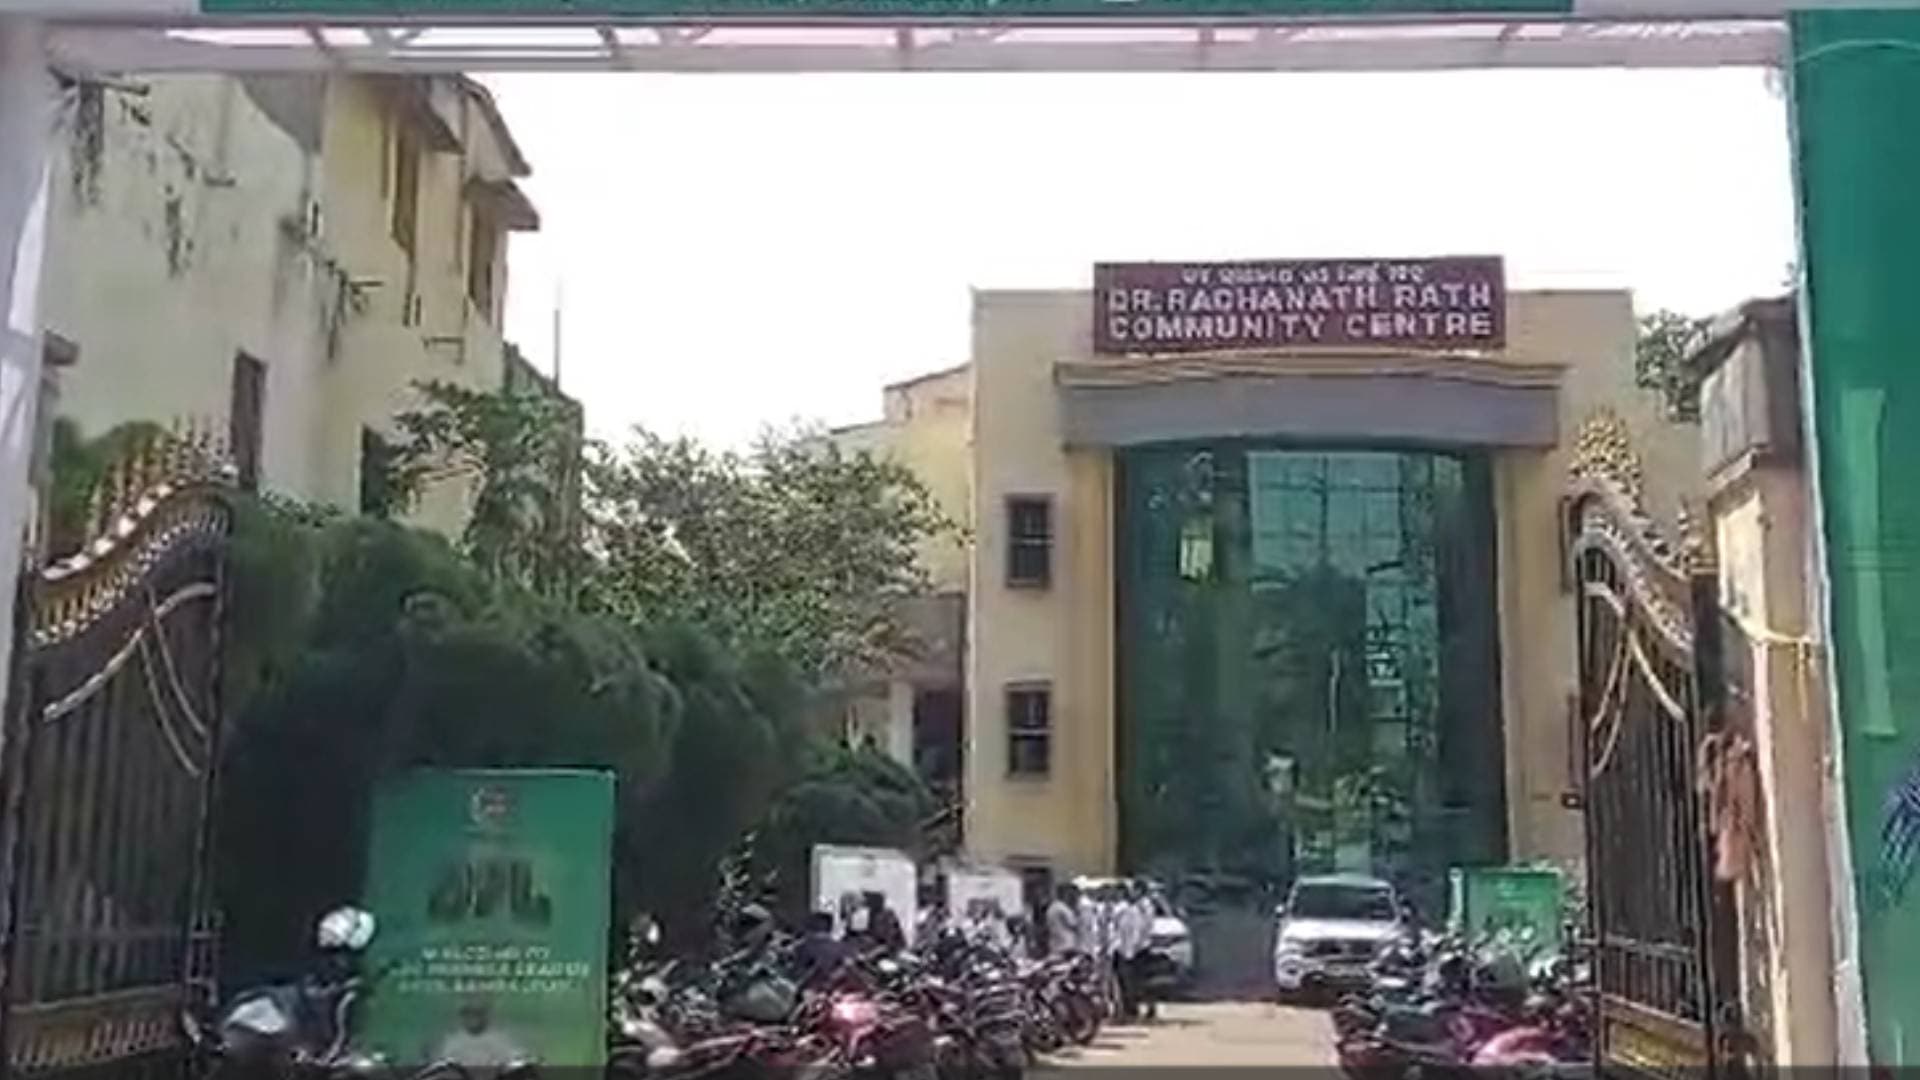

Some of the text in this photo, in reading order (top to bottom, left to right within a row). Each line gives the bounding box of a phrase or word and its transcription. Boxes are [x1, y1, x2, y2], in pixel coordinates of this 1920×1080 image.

[1393, 283, 1492, 308] RATH
[1109, 312, 1492, 340] COMMUNITY CENTRE
